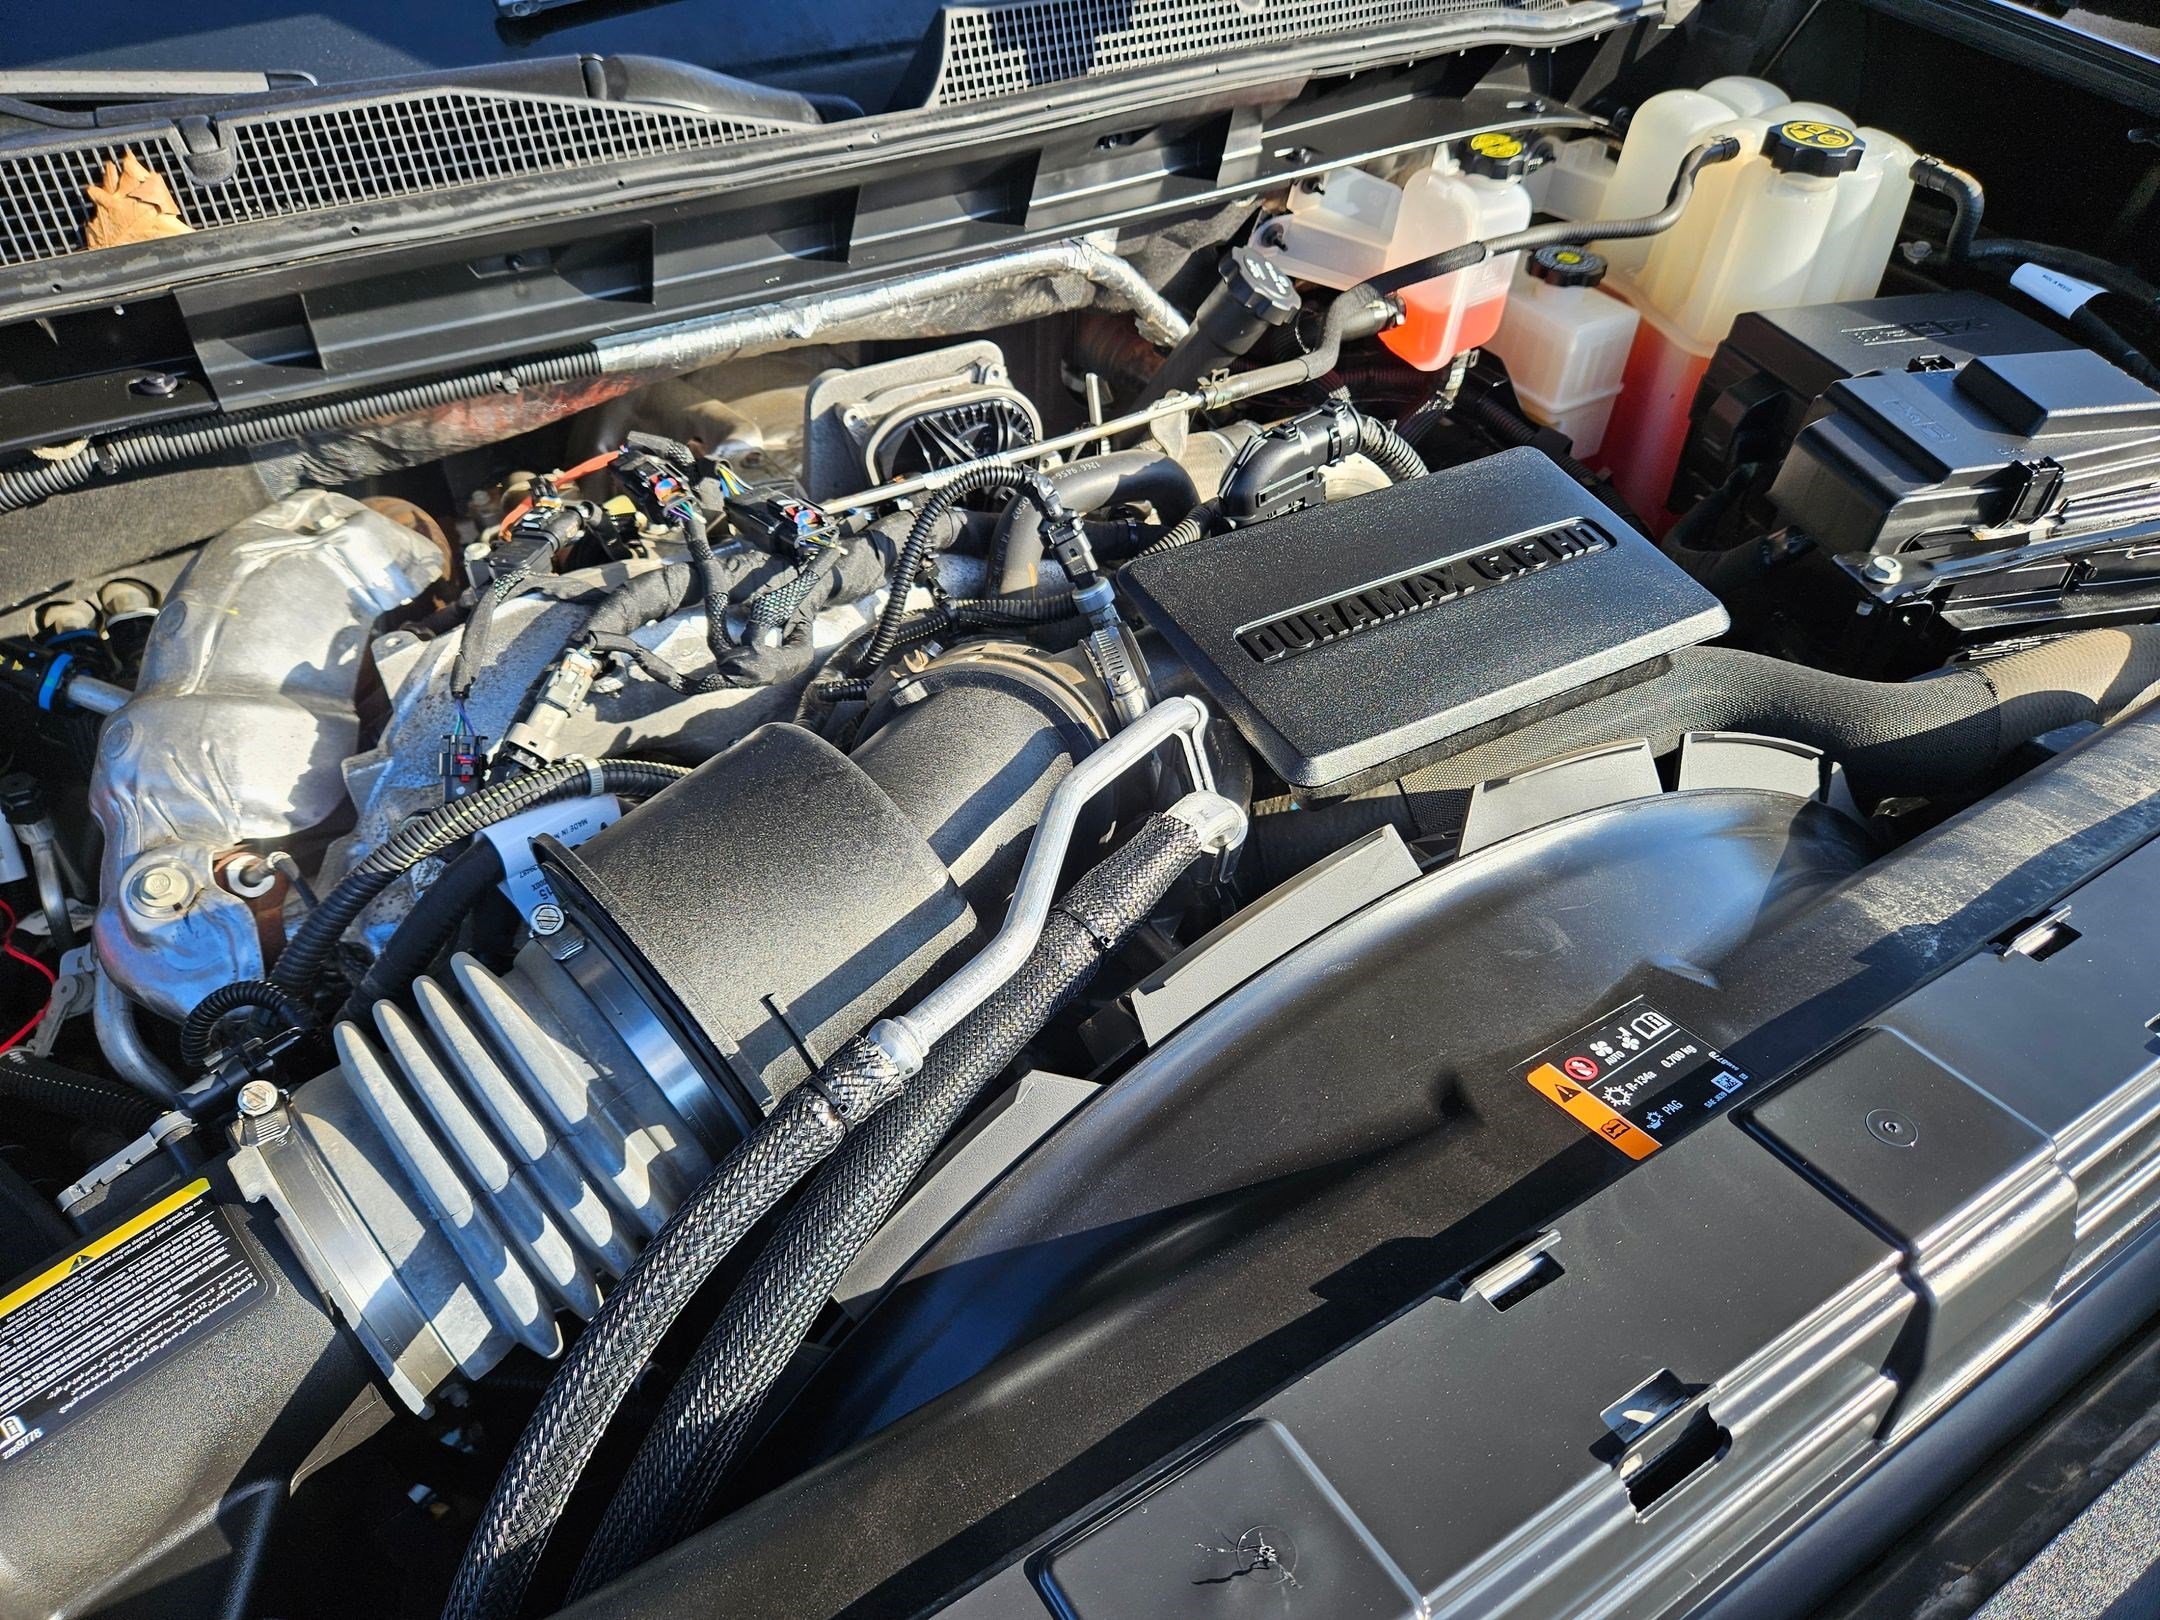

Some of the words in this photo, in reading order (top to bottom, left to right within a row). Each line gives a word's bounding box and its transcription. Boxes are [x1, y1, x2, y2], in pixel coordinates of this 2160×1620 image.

[1242, 565, 1475, 663] DURAMAX
[570, 818, 588, 832] MADE
[1604, 1051, 1625, 1066] AUTO
[1625, 1070, 1657, 1092] R-134a
[1660, 1051, 1686, 1068] 0.700
[1681, 1044, 1698, 1056] kg
[1663, 1099, 1684, 1120] PAG
[1, 1326, 16, 1339] Plug
[15, 1311, 41, 1330] Starting
[39, 1297, 63, 1315] System
[74, 1278, 94, 1292] result.
